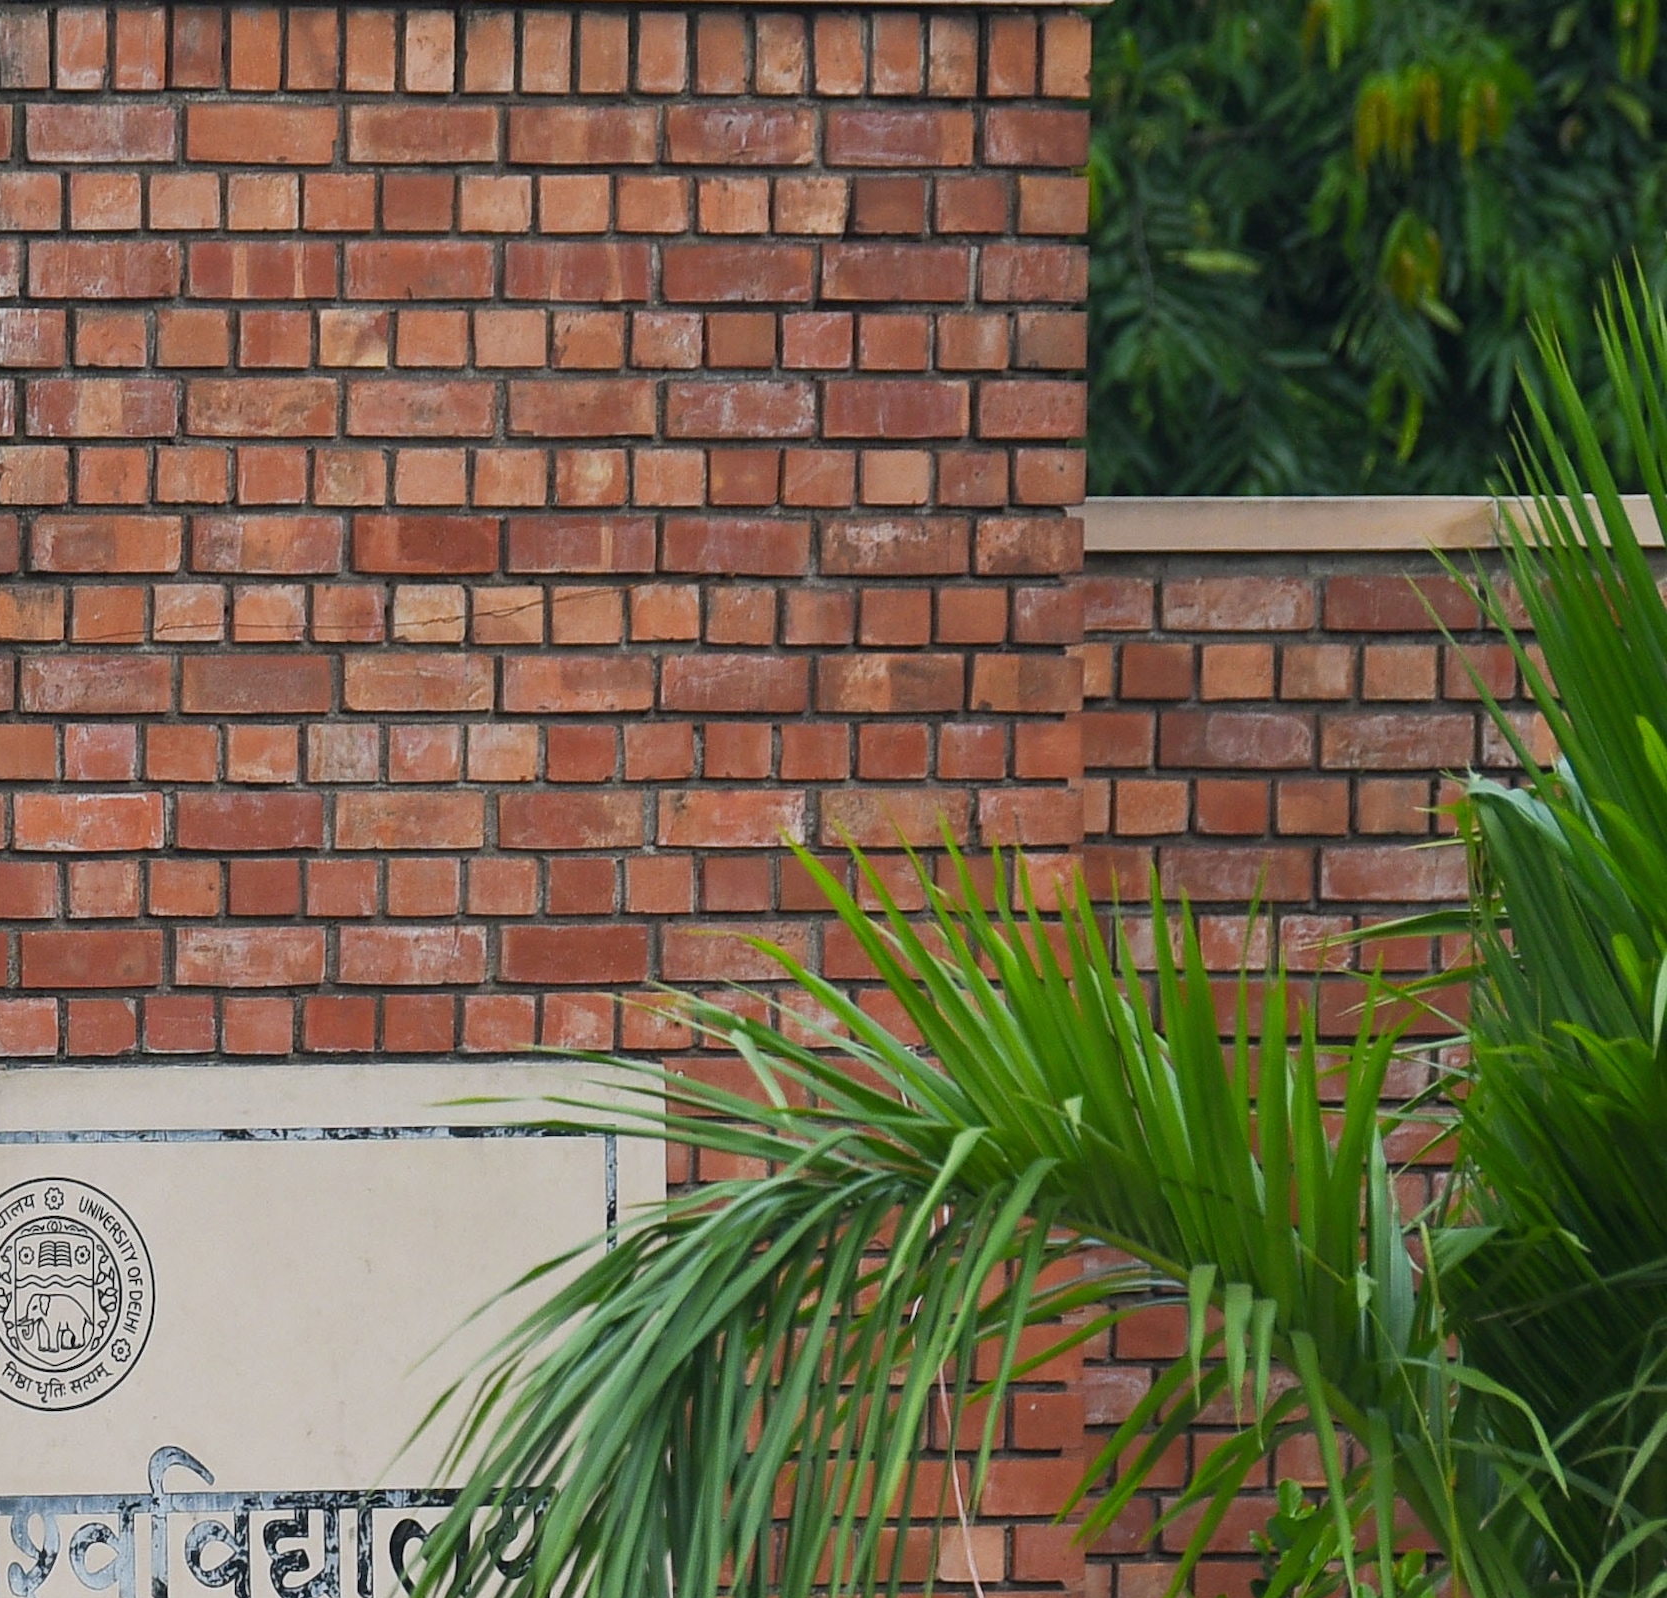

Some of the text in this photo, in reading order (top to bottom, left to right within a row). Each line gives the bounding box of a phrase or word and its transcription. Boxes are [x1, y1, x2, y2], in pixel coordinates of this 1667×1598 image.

[78, 1195, 144, 1335] UNIVERSITY OF DELHI
